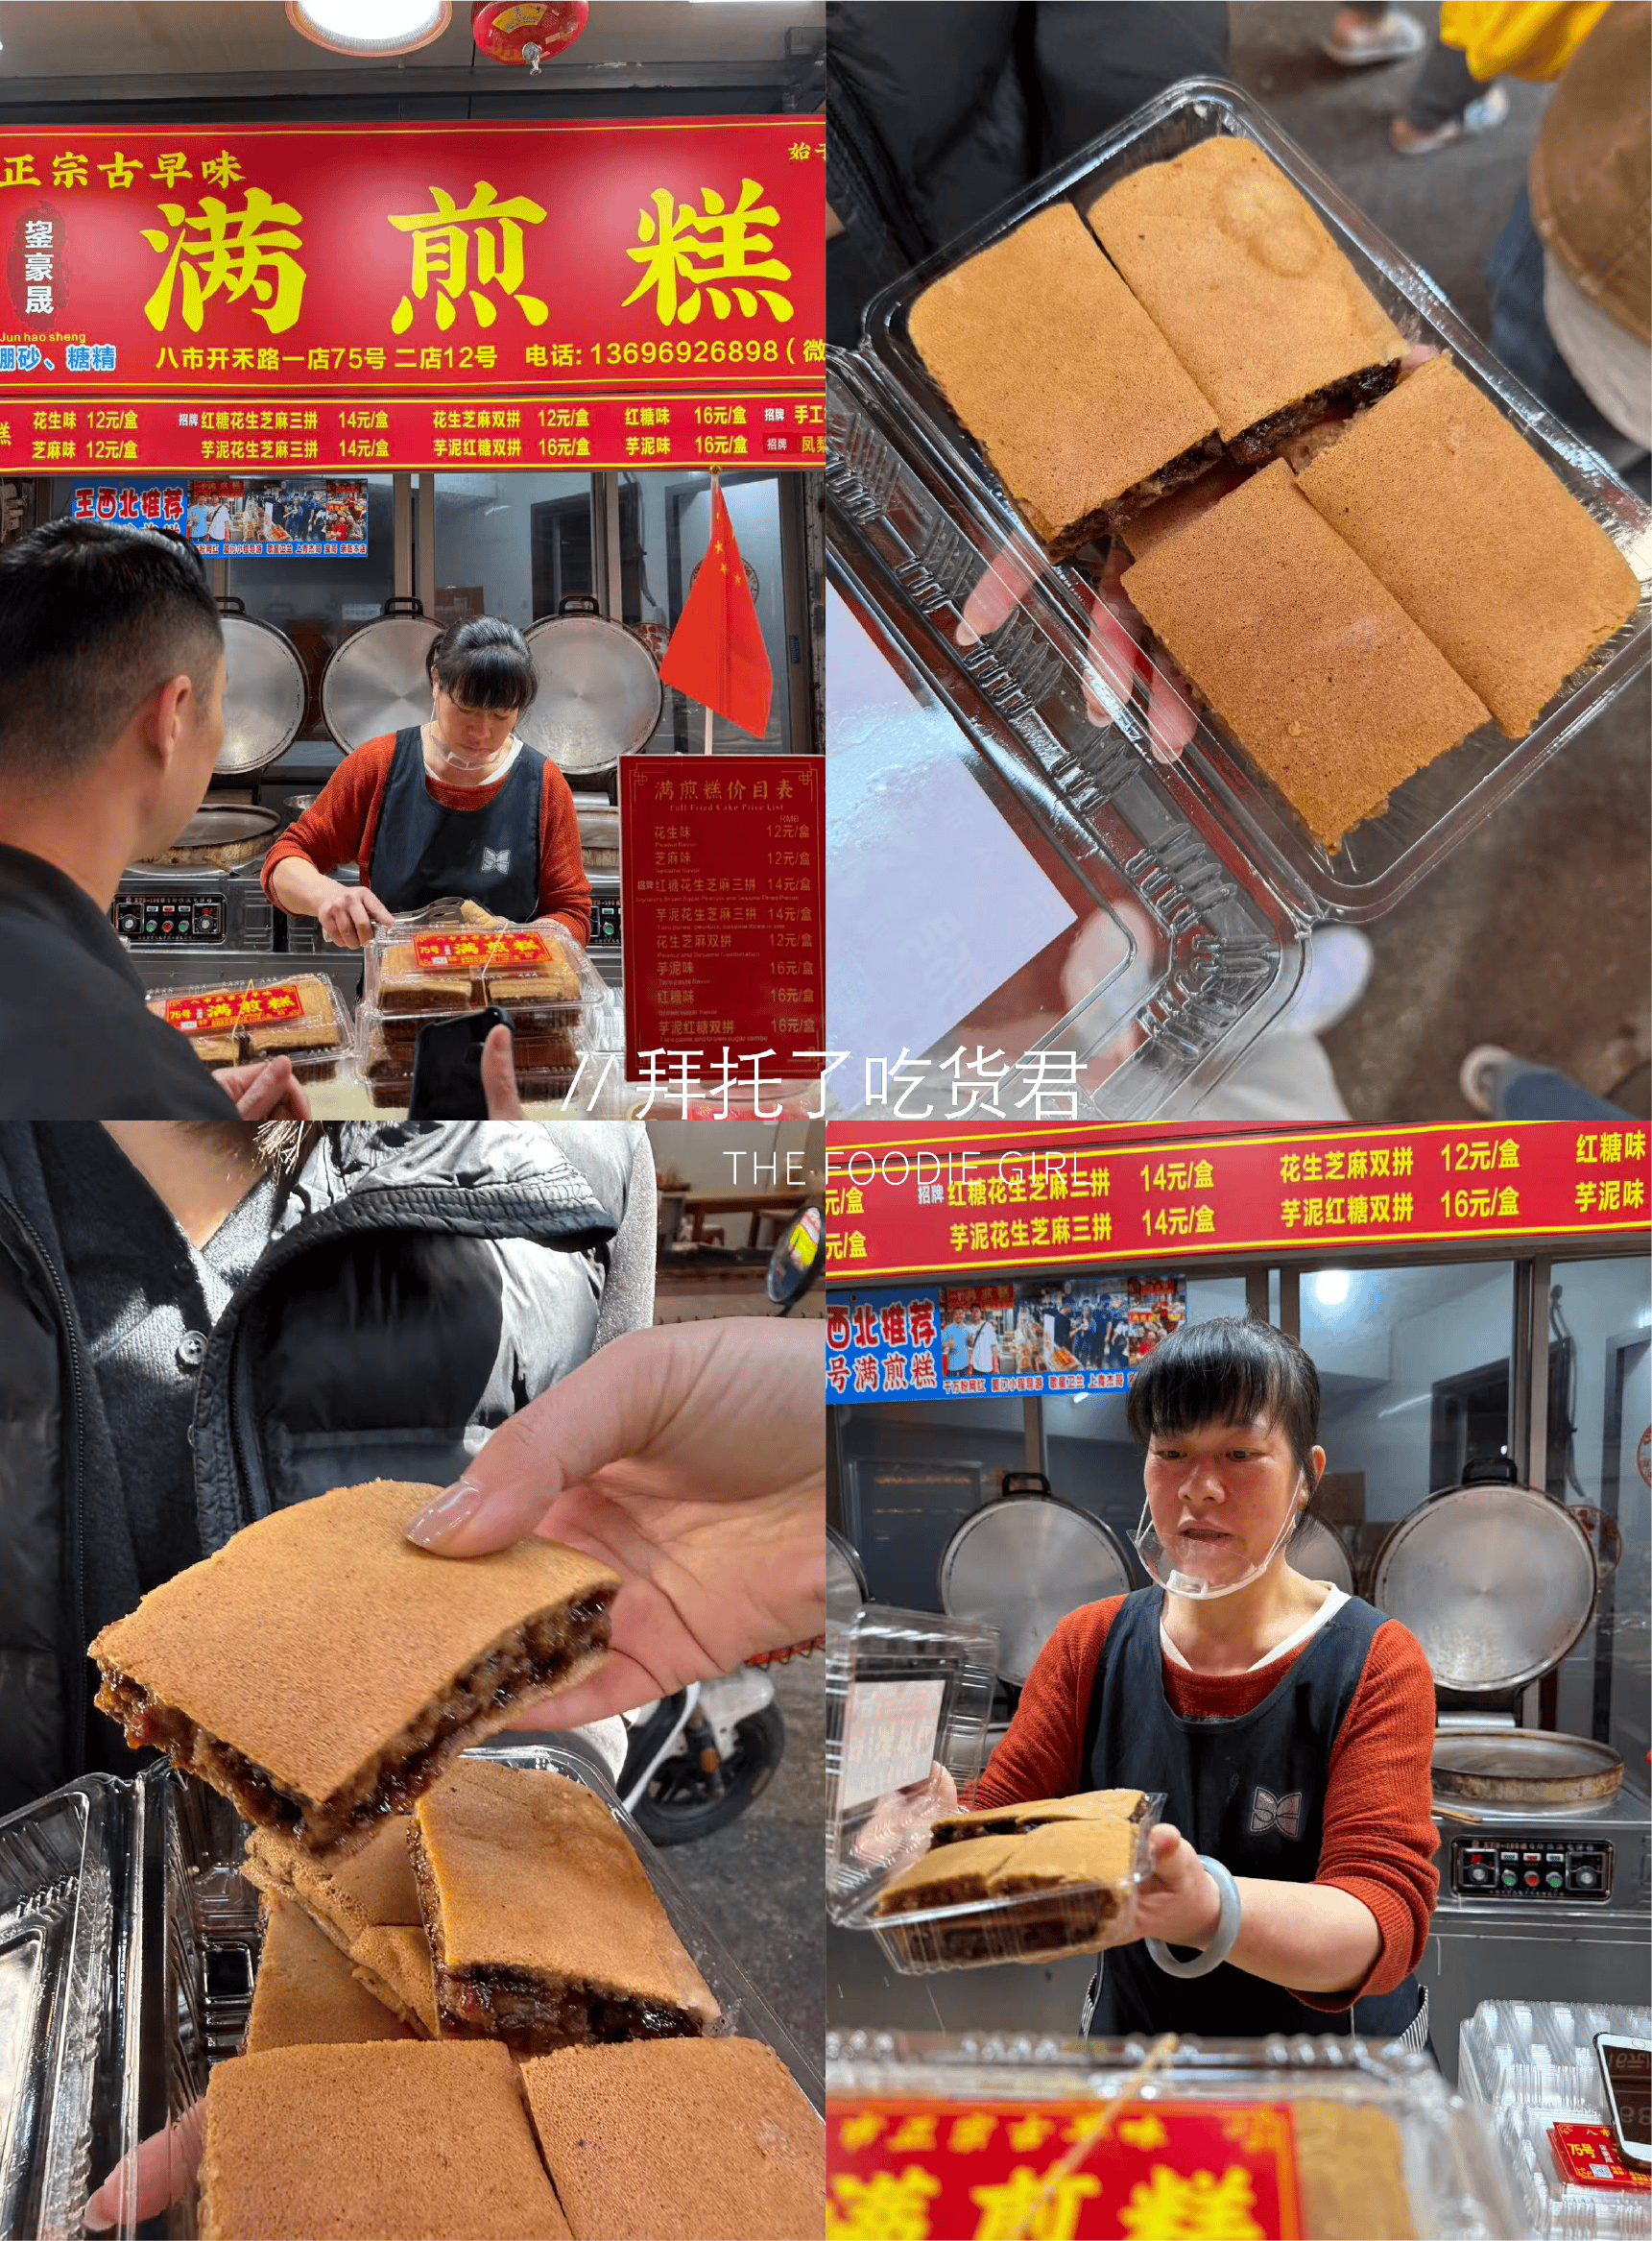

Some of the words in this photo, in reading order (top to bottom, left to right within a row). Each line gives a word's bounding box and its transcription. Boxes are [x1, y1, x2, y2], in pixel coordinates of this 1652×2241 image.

[0, 150, 247, 189] 正宗古早味
[140, 178, 795, 334] 满煎糕
[0, 332, 22, 343] Jun
[24, 332, 46, 343] hao
[49, 332, 86, 344] sheng
[156, 347, 386, 371] 八市开禾路一店75号
[395, 346, 497, 370] 二店12号
[33, 410, 77, 430] 花生味
[87, 411, 138, 430] 12元/盒
[179, 413, 199, 426] 招牌
[201, 411, 318, 430] 红糖花生芝麻三拼
[339, 411, 389, 430] 14元/盒
[433, 409, 520, 429] 花生芝麻双拼
[538, 408, 589, 428] 12元/盒
[625, 407, 670, 426] 红糖味
[695, 405, 747, 425] 16元/盒
[764, 408, 784, 422] 招牌
[795, 405, 826, 423] 手工
[32, 440, 76, 460] 芝麻味
[87, 439, 138, 459] 12元/盒
[201, 439, 318, 459] 芋泥花生芝麻三拼
[339, 439, 389, 458] 14元/盒
[434, 438, 521, 457] 芋泥红糖双拼
[539, 437, 590, 456] 16元/盒
[625, 436, 670, 456] 芋泥味
[695, 434, 748, 454] 16元/盒
[767, 438, 787, 451] 招牌
[75, 487, 184, 519] 王西北推荐
[655, 779, 793, 801] 满煎糕价目表
[767, 803, 783, 811] List
[654, 826, 690, 839] 花生味
[766, 824, 810, 838] 12元/盒
[655, 852, 691, 865] 芝麻味
[767, 852, 810, 866] 12元/盒
[655, 878, 755, 892] 红糖花生芝麻三拼
[768, 878, 811, 891] 14元/盒
[656, 907, 756, 922] 芋泥花生芝麻三拼
[768, 907, 812, 922] 14元/盒
[657, 934, 731, 949] 花生芝麻双拼
[769, 933, 812, 948] 12元/盒
[657, 961, 694, 976] 芋泥味
[771, 961, 813, 975] 16元/盒
[658, 990, 694, 1004] 红糖味
[771, 988, 814, 1002] 16元/盒
[658, 1020, 734, 1035] 芋泥红糖双拼
[918, 1185, 945, 1205] 招牌
[947, 1168, 1110, 1208] 红糖花生芝麻三拼
[1140, 1159, 1214, 1193] 14元/盒
[1280, 1145, 1413, 1183] 花生芝麻双拼
[1441, 1138, 1520, 1171] 12元/盒
[1575, 1129, 1647, 1165] 红糖味
[949, 1213, 1112, 1252] 芋泥花生芝麻三拼
[1141, 1204, 1215, 1237] 14元/盒
[1281, 1192, 1413, 1229] 芋泥红糖双拼
[1441, 1186, 1520, 1219] 16元/盒
[1575, 1178, 1645, 1214] 芋泥味
[826, 1351, 938, 1394] 号满煎糕
[1567, 2143, 1596, 2158] 75号
